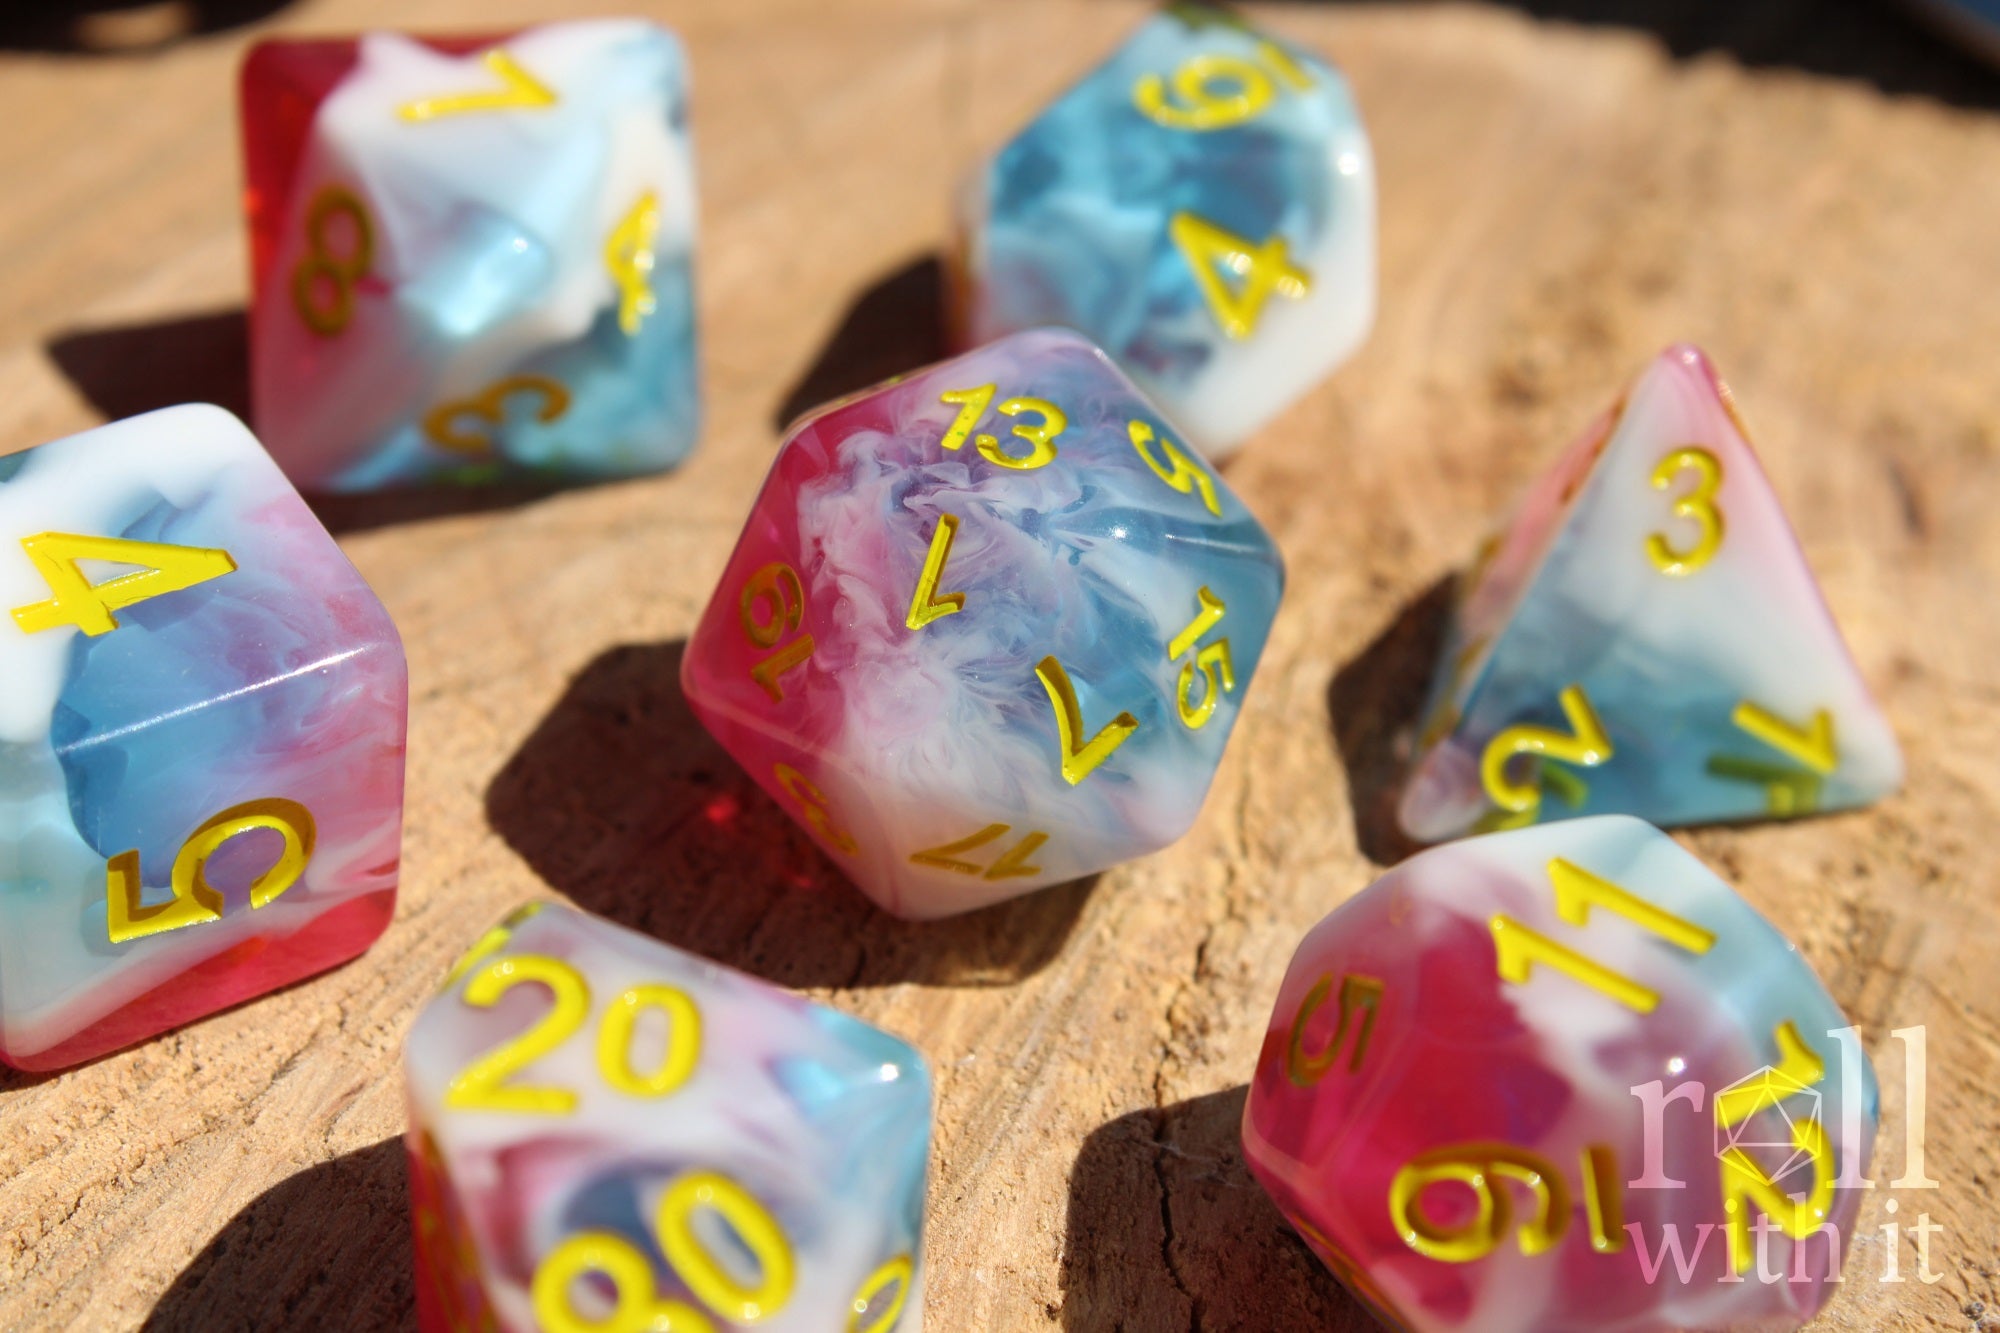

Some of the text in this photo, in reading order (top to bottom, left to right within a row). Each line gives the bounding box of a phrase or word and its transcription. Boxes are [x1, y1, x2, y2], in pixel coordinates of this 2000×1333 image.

[293, 185, 375, 338] 8
[606, 189, 660, 335] 4
[1168, 210, 1314, 341] 4
[421, 374, 571, 454] 3
[940, 383, 1068, 470] 13
[1128, 420, 1223, 518] 5
[1645, 446, 1725, 577] 3
[10, 531, 239, 637] 4
[1035, 655, 1141, 787] 7
[1168, 585, 1236, 730] 15
[1481, 683, 1614, 812] 2
[106, 797, 317, 943] 5
[1487, 856, 1718, 1015] 11
[443, 954, 704, 1115] 20
[1286, 971, 1386, 1088] 5
